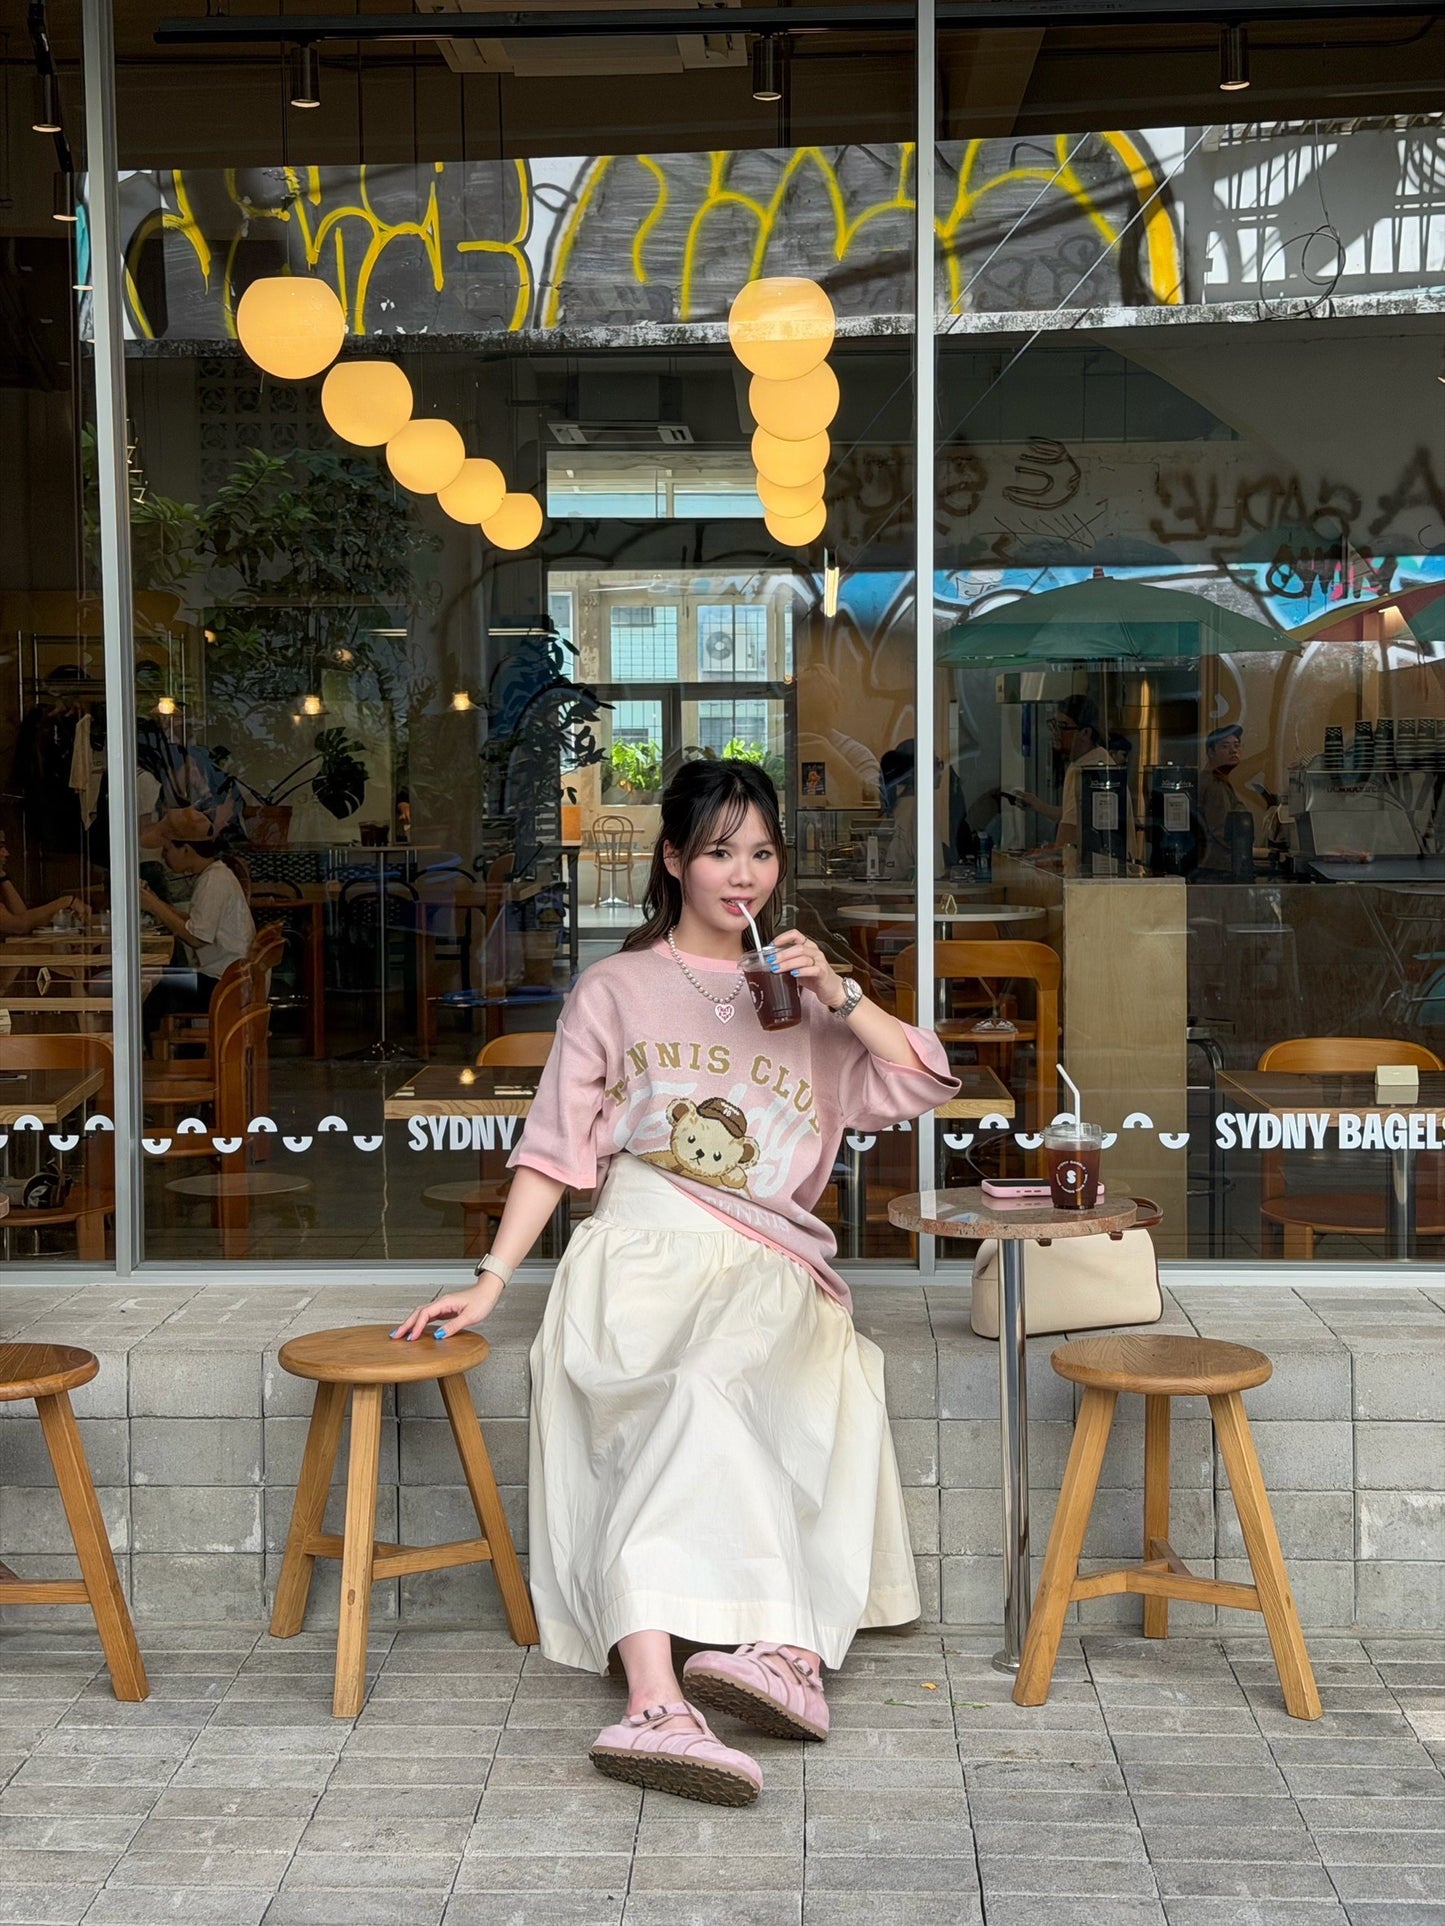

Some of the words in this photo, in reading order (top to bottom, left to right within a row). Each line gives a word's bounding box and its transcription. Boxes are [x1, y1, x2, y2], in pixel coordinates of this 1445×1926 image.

[604, 1040, 731, 1108] TNNIS
[407, 1114, 518, 1152] SYDNY
[1215, 1112, 1330, 1150] SYDNY
[1338, 1112, 1445, 1150] BAGEL
